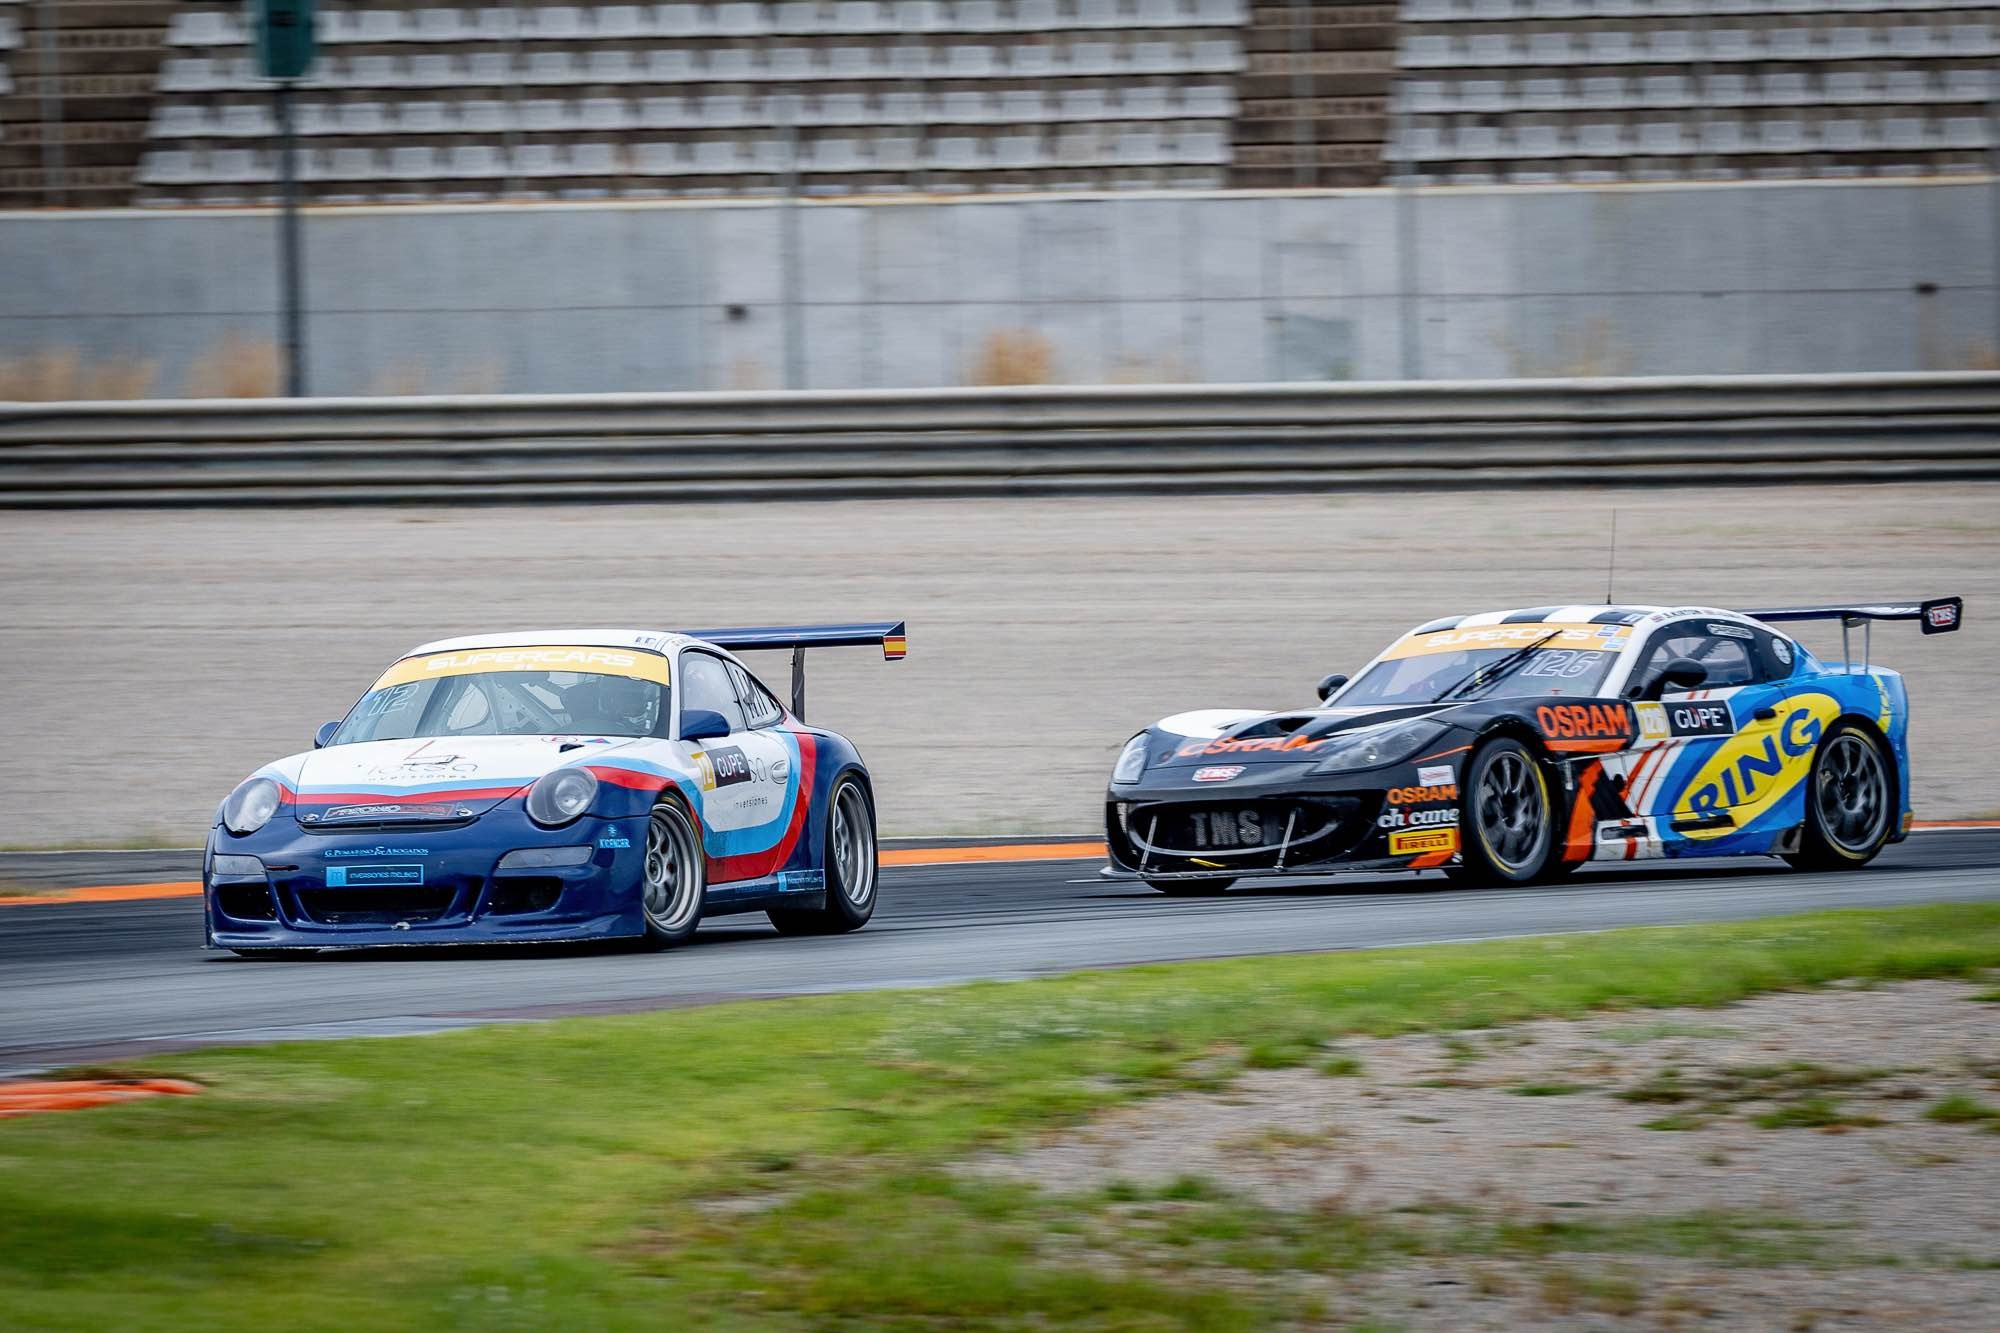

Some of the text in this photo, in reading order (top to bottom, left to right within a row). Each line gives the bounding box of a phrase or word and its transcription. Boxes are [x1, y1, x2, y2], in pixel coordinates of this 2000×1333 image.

[1425, 629, 1592, 648] SUPERCARS
[426, 649, 636, 672] SUPERCARS
[1520, 650, 1605, 678] 126
[1536, 704, 1631, 738] OSRAM
[1689, 708, 1822, 818] RING
[1386, 784, 1458, 805] OSRAM
[1190, 810, 1262, 846] TMS
[1377, 807, 1459, 828] chicane
[1396, 833, 1449, 850] PIRELLI
